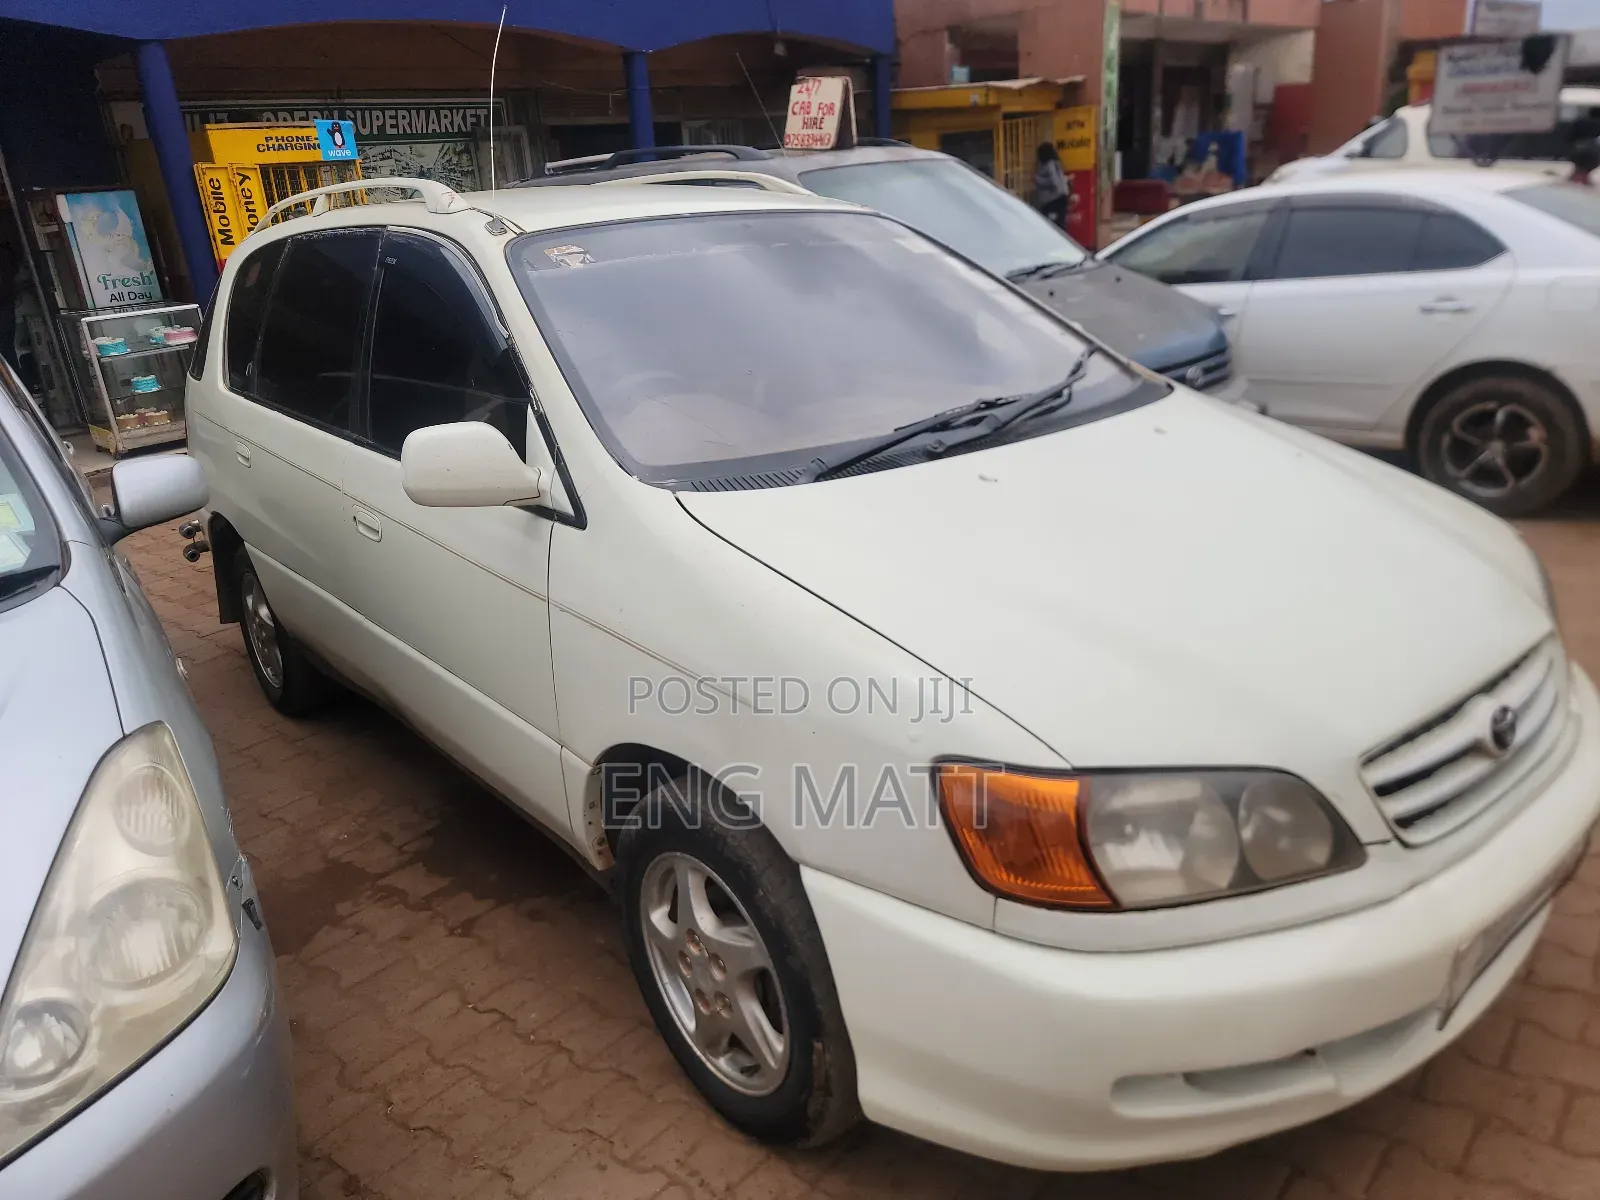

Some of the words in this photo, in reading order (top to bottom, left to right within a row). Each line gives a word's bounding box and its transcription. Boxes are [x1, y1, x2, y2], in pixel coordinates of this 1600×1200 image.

[791, 101, 812, 116] CAB
[817, 102, 836, 116] FOR
[344, 107, 488, 136] SUPERMARKET
[802, 116, 824, 130] HIRE
[328, 149, 352, 157] wave
[209, 177, 235, 246] Mobile
[97, 271, 154, 290] Fresh
[109, 292, 125, 303] All
[128, 291, 153, 301] Day
